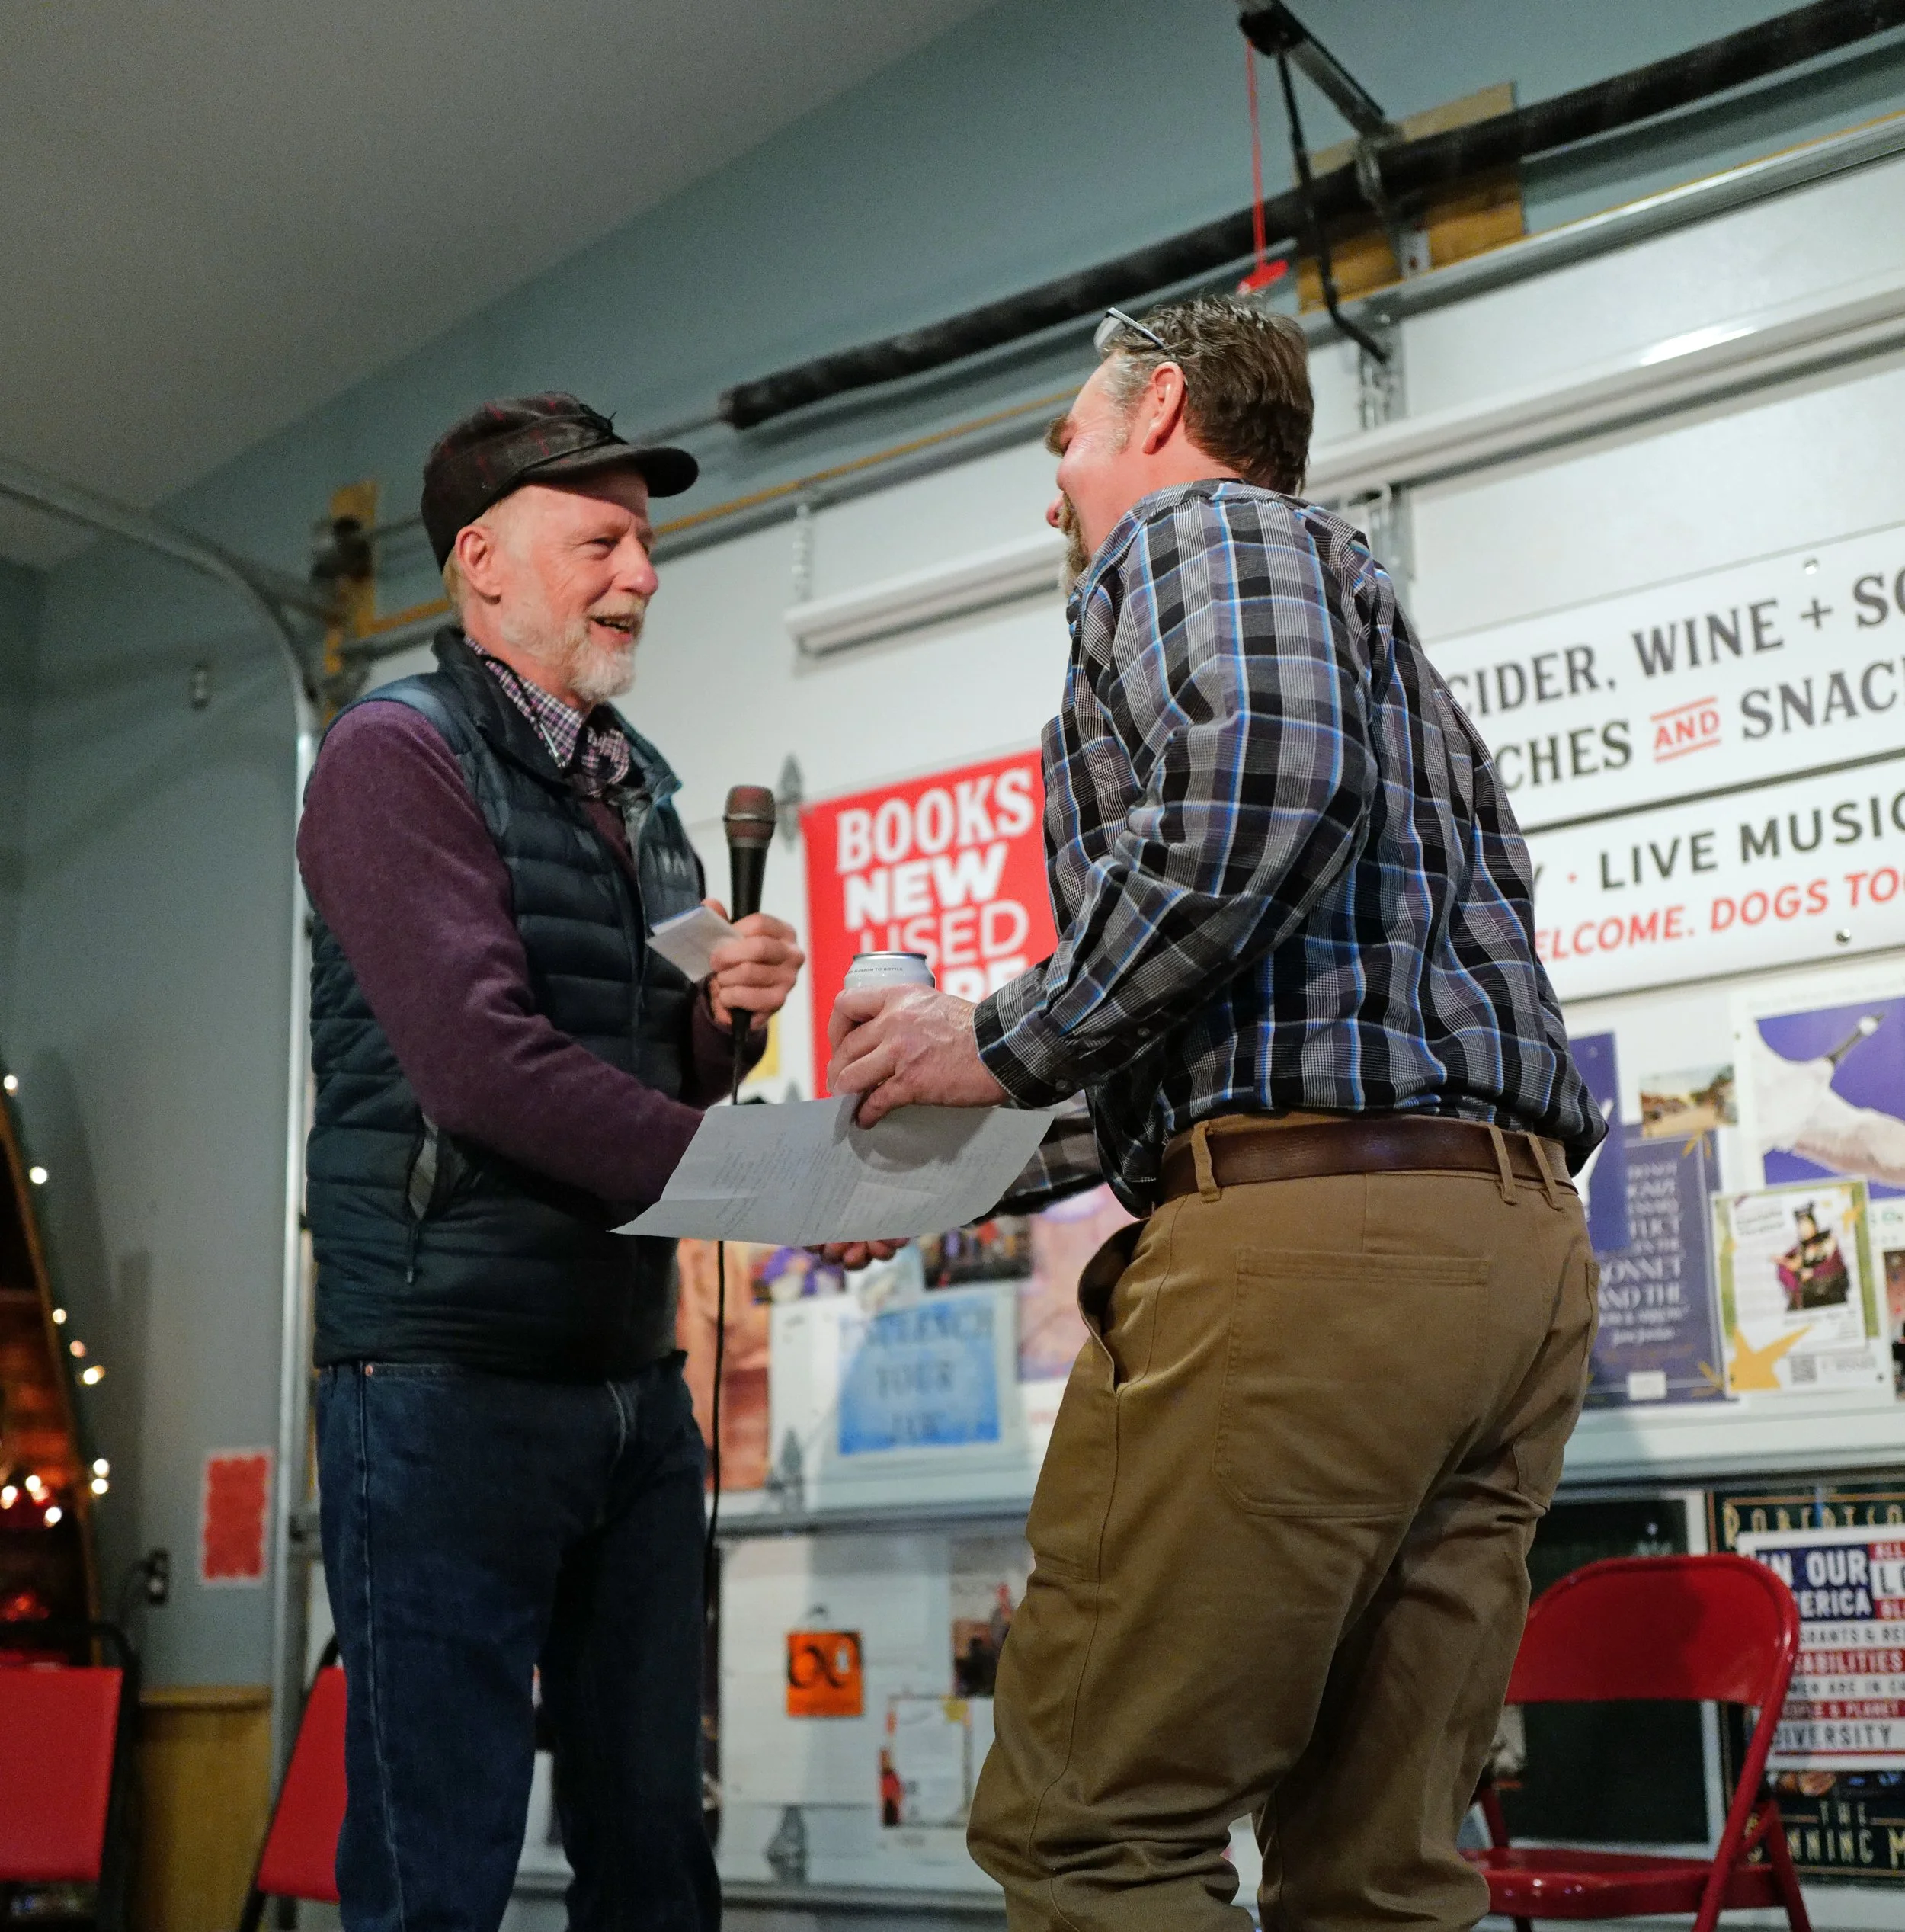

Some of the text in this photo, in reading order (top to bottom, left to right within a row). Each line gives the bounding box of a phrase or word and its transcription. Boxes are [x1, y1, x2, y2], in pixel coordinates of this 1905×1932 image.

[1630, 598, 1785, 679] WINE
[1654, 709, 1721, 751] AND
[1739, 657, 1905, 741] SNAC
[836, 767, 1036, 873] BOOKS
[1600, 829, 1718, 890] LIVE
[843, 841, 1008, 931] NEW
[1711, 879, 1830, 934] DOGS
[1843, 866, 1905, 908] TO
[1806, 1549, 1868, 1588] OUR
